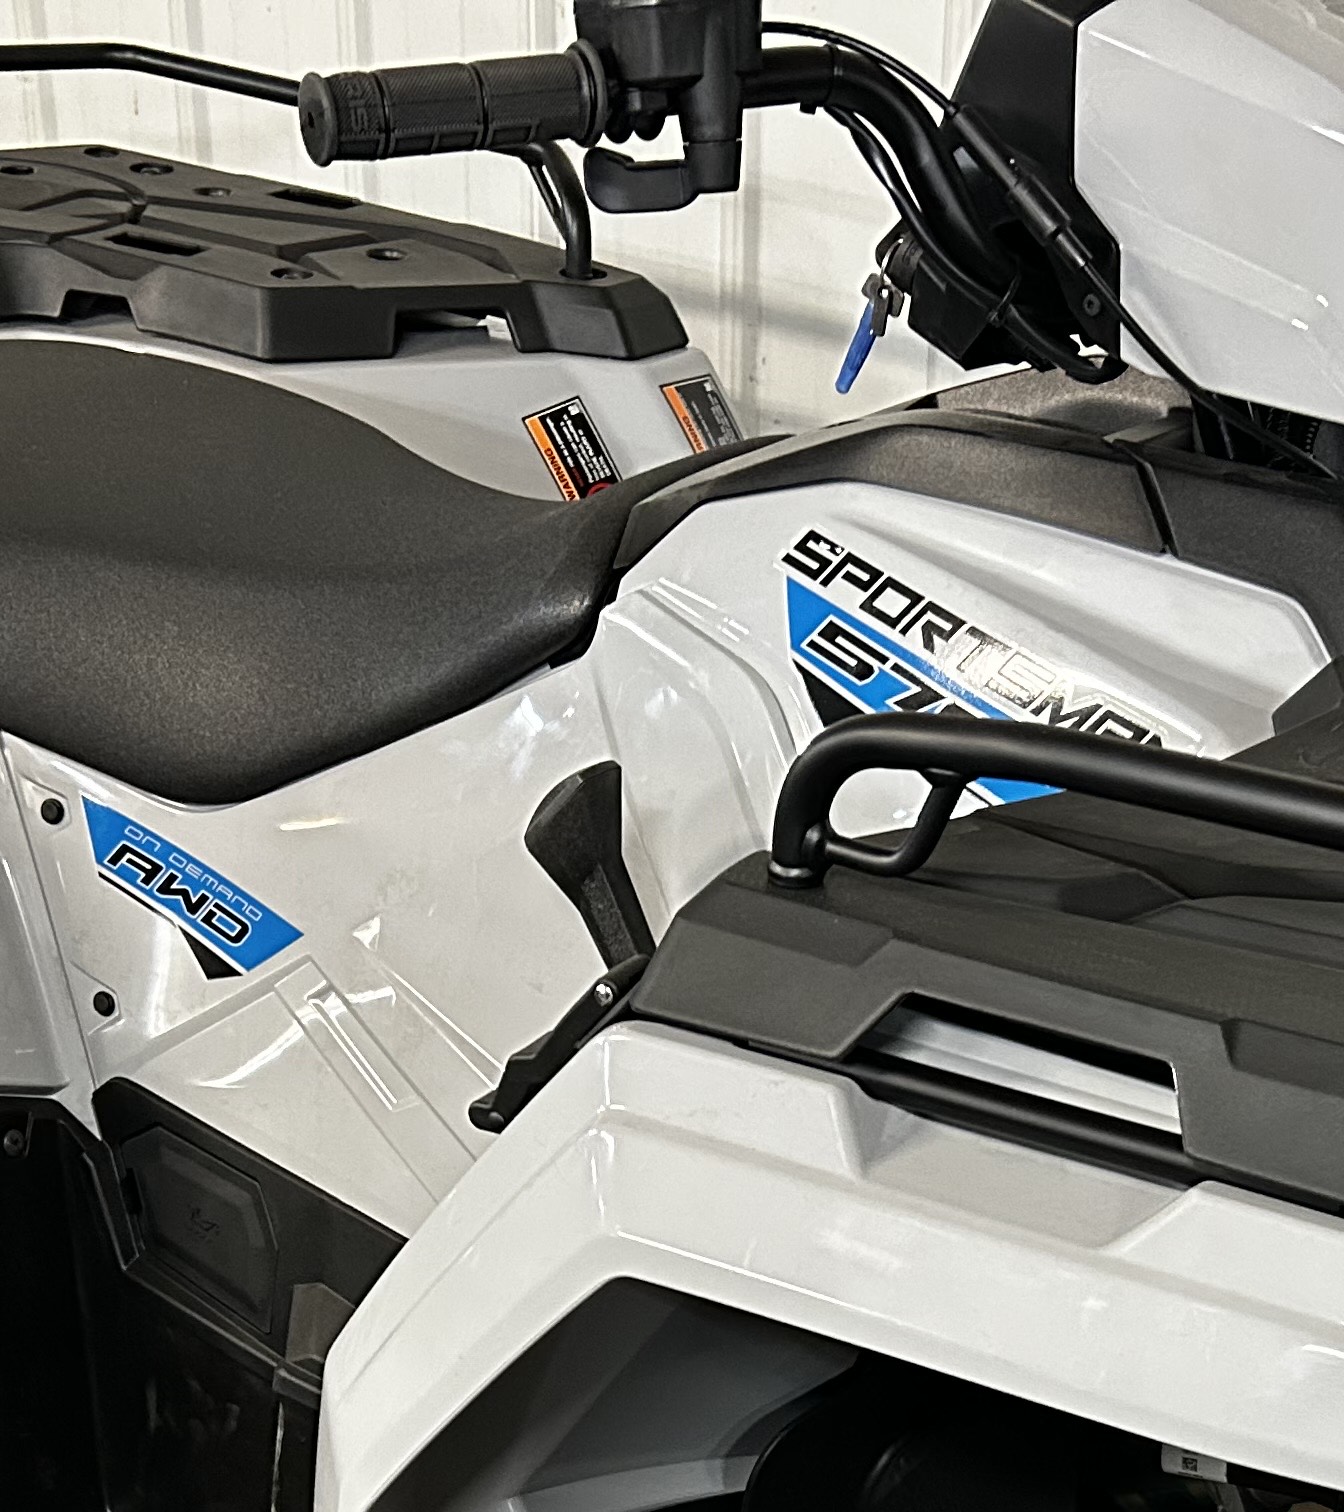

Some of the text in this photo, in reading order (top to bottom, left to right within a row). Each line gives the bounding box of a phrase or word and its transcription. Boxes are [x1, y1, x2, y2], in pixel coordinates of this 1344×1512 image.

[544, 447, 577, 501] WARNING
[682, 415, 704, 451] RNING
[781, 529, 1163, 750] SPORTSMA
[803, 617, 986, 717] 57
[104, 841, 252, 947] AWD
[124, 826, 263, 921] ON DEMAND
